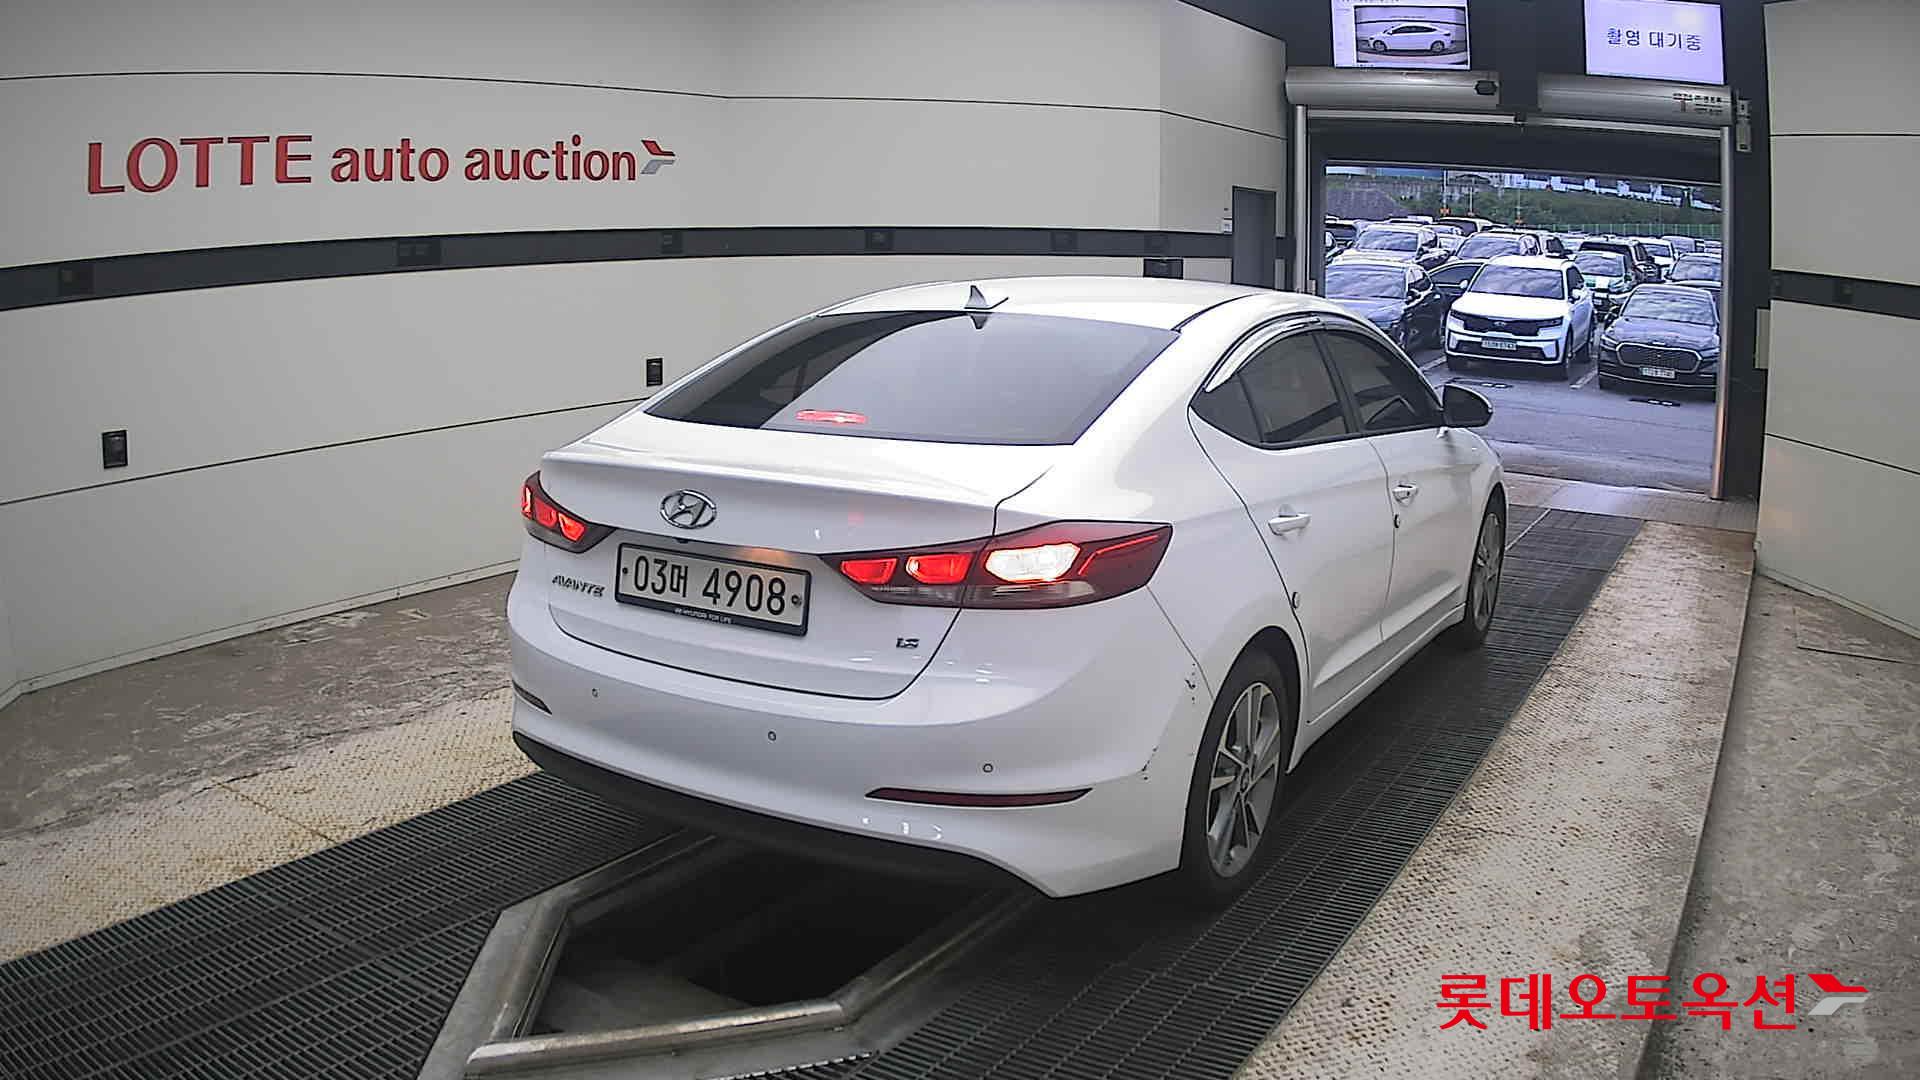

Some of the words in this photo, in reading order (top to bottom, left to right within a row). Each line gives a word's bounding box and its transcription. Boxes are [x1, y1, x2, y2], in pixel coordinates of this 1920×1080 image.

[1607, 27, 1640, 47] 촬영
[1649, 30, 1702, 51] 대기중
[88, 135, 312, 194] LOTTE
[330, 138, 449, 182] auto
[464, 134, 637, 181] auction
[551, 575, 606, 598] AVANTE
[633, 555, 689, 598] 03머
[702, 567, 786, 616] 4908
